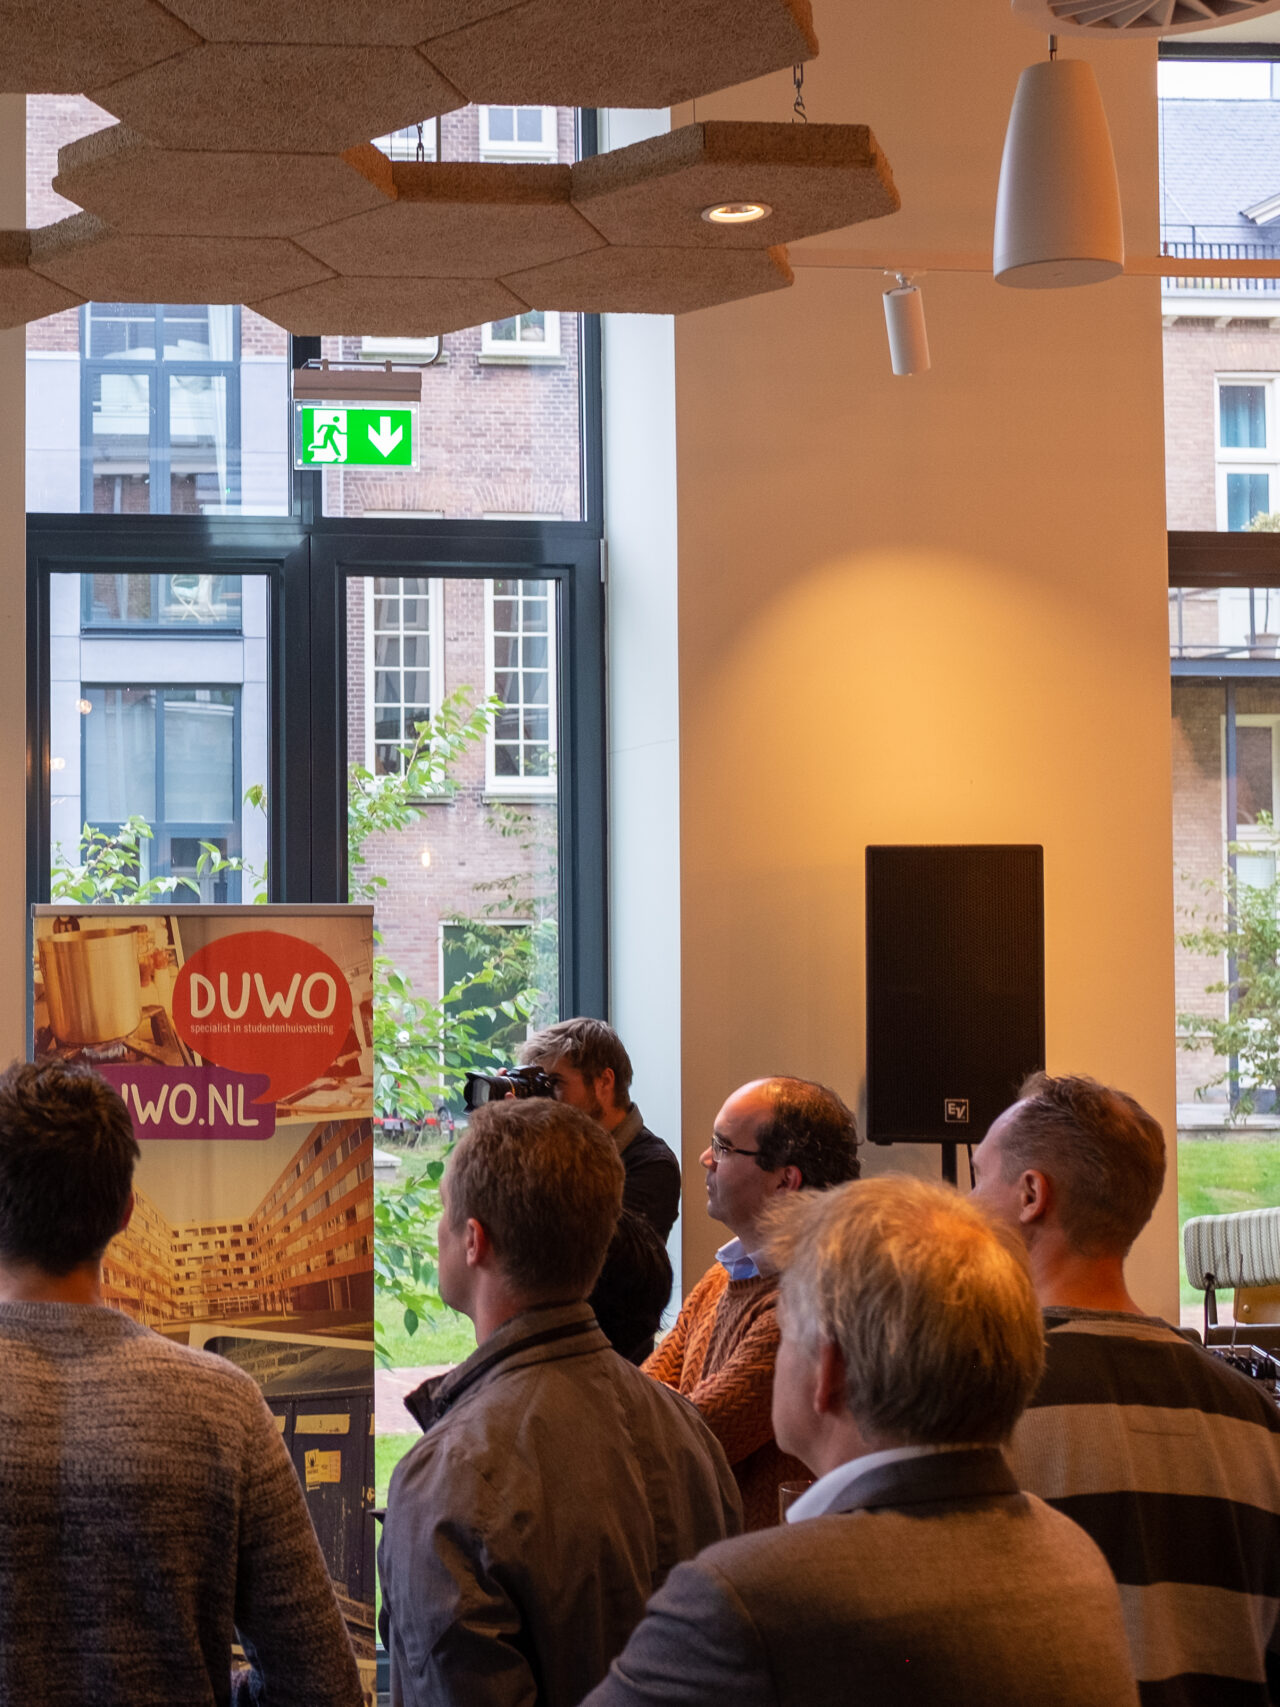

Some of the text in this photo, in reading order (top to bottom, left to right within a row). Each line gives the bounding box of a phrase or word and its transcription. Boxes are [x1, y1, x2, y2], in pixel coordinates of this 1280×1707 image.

[190, 972, 337, 1019] DUWO
[190, 1023, 334, 1035] specialist in studentenhuisvesting
[121, 1083, 260, 1127] WO.NL
